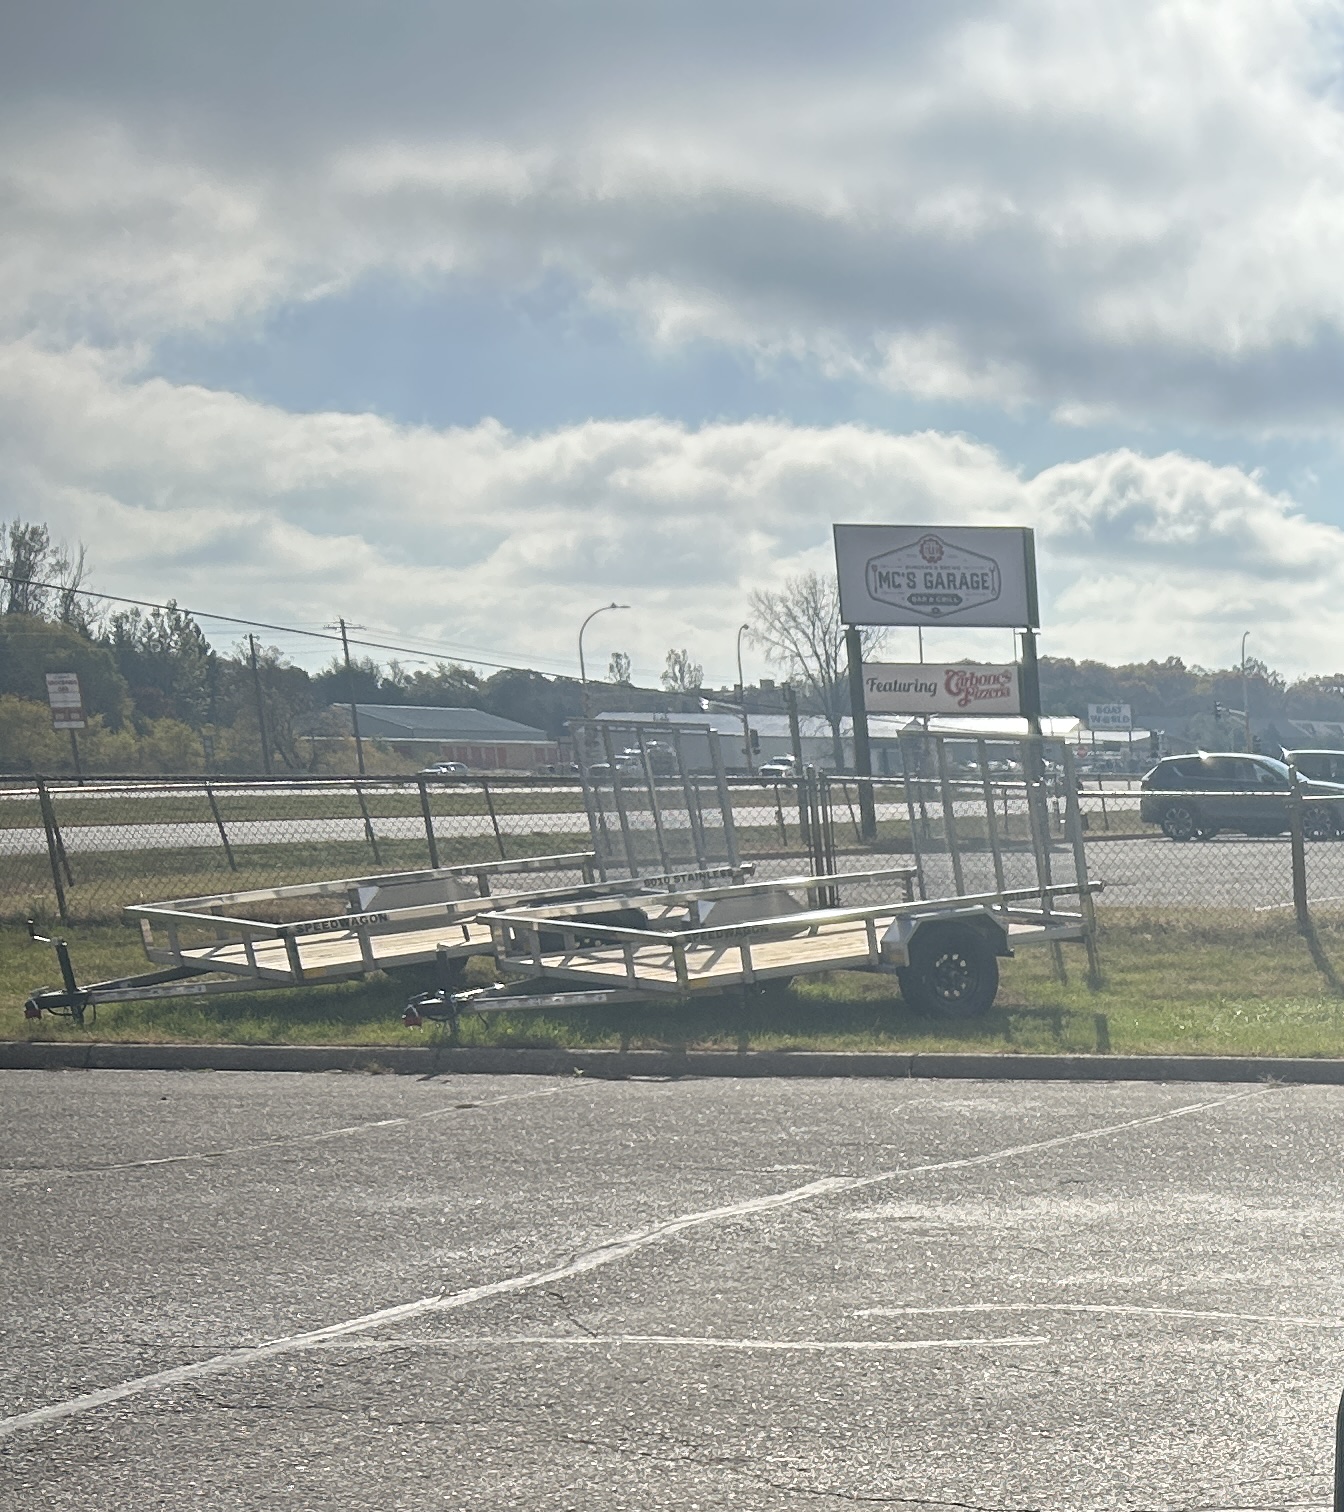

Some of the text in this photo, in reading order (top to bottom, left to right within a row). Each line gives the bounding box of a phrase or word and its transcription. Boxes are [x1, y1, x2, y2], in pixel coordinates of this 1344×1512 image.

[878, 571, 990, 590] MC'S GARAGE
[866, 677, 937, 697] Featuring
[296, 913, 389, 934] SPEEDWAGON
